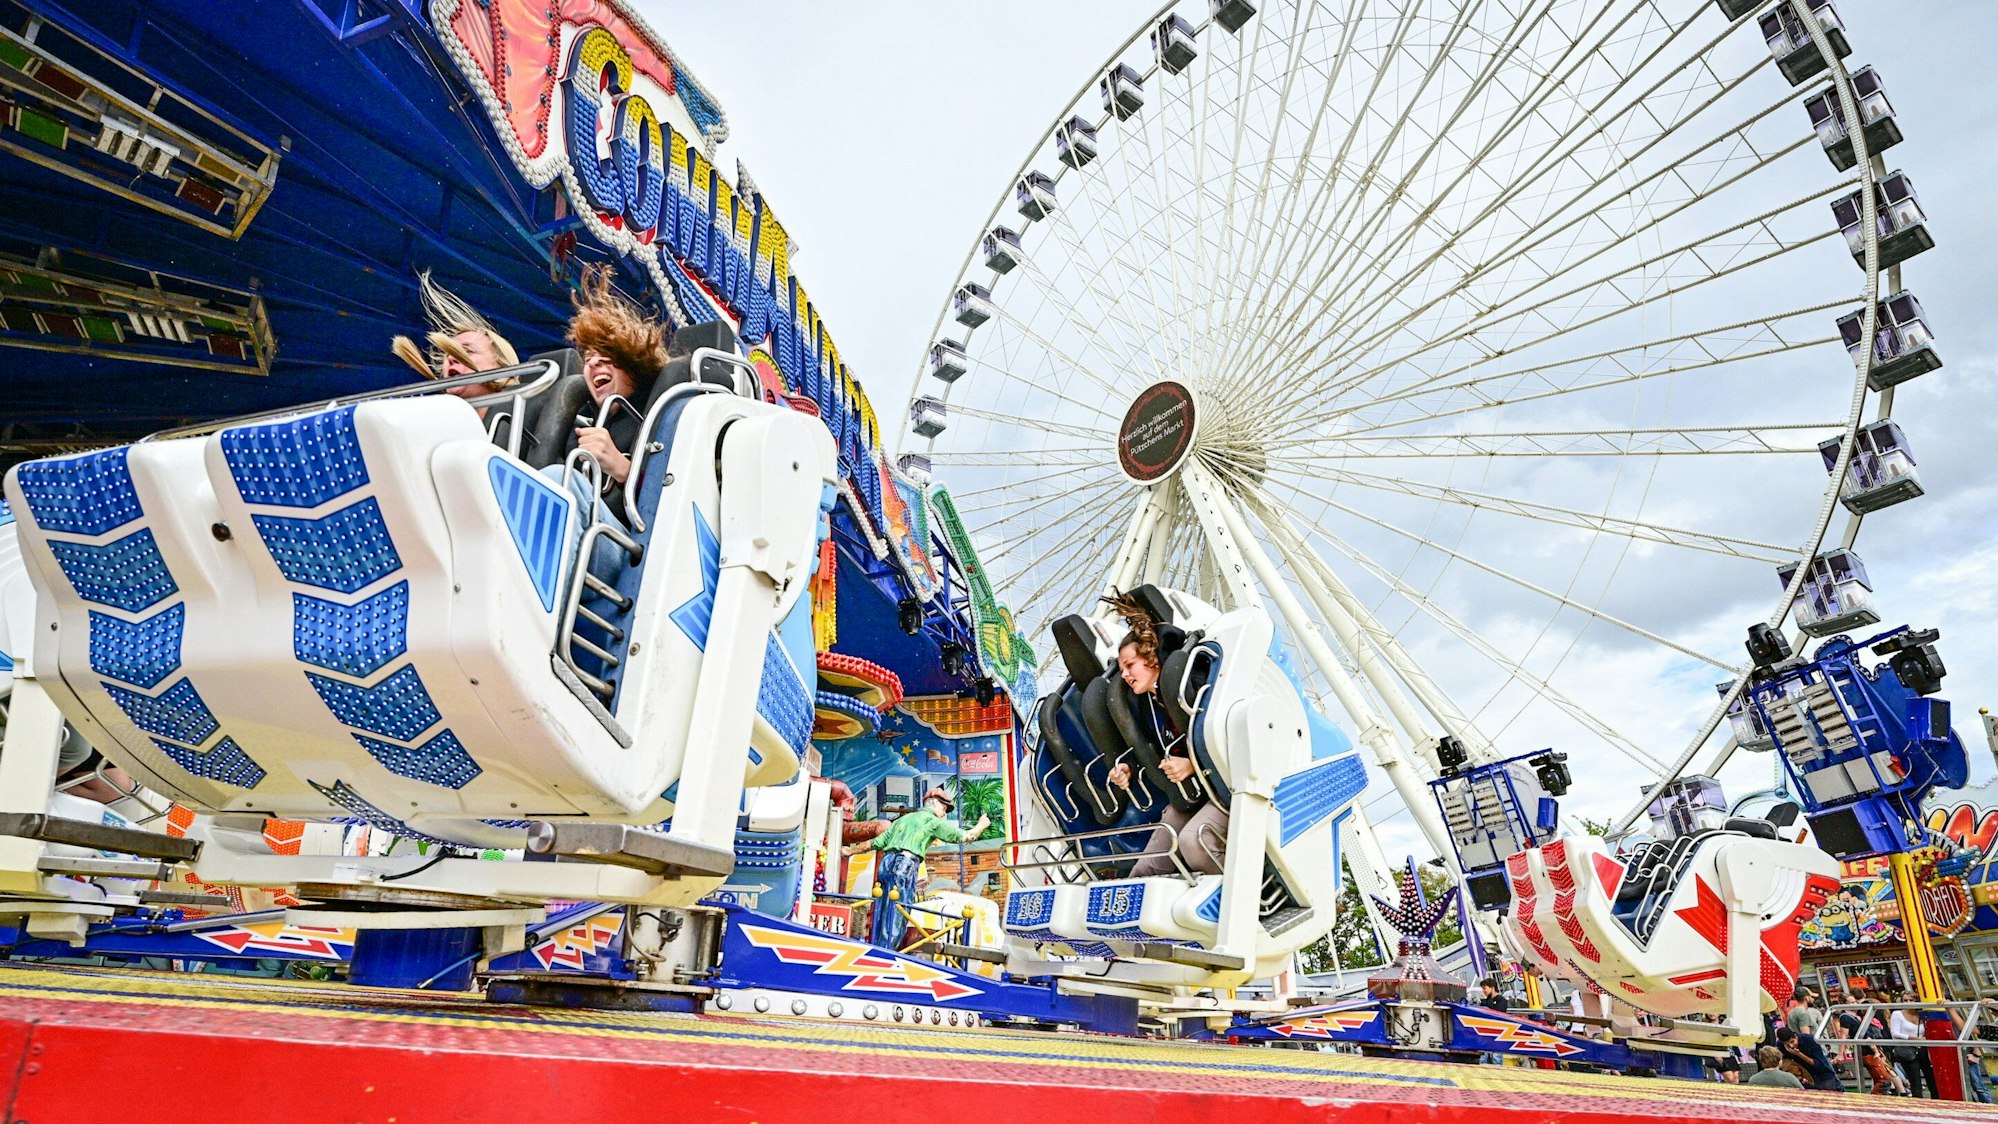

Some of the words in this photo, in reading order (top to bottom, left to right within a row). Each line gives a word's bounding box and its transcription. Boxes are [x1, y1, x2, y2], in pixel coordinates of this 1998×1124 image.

[560, 26, 884, 537] COMMANDER
[1121, 423, 1147, 444] Herzlich
[1147, 400, 1188, 428] willkommen
[1130, 433, 1163, 456] Pützchens
[1163, 419, 1184, 437] Markt
[1142, 428, 1153, 441] auf
[1153, 420, 1169, 434] dem
[1017, 893, 1043, 920] 16
[1099, 886, 1131, 916] 15
